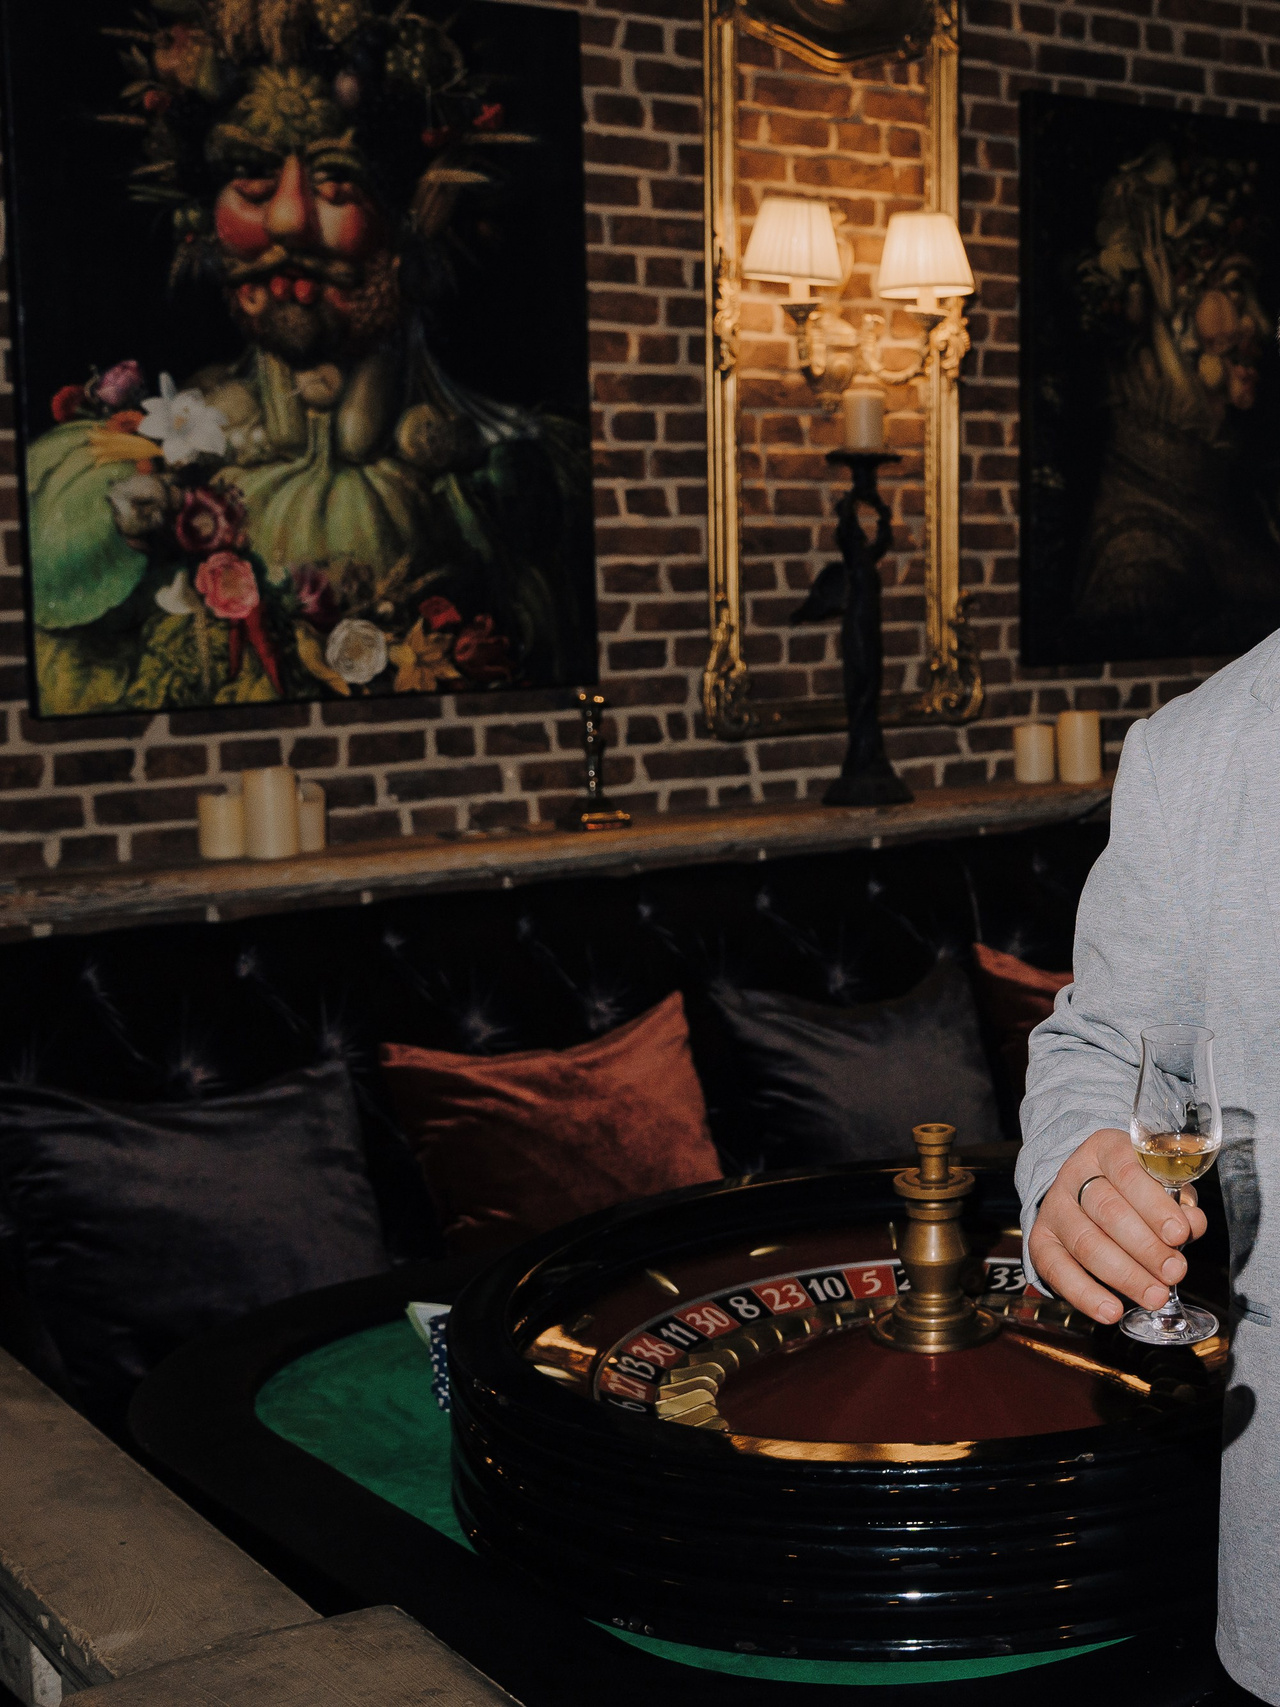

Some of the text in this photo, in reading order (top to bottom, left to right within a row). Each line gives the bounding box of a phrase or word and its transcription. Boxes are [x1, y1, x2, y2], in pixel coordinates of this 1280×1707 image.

[807, 1276, 846, 1302] 10
[861, 1269, 882, 1295] 5
[990, 1266, 1027, 1291] 33
[728, 1295, 761, 1319] 8
[761, 1283, 807, 1311] 23
[660, 1321, 700, 1346] 11
[685, 1306, 730, 1335] 30
[631, 1337, 676, 1366] 36
[616, 1355, 656, 1380] 13
[607, 1372, 647, 1400] 27
